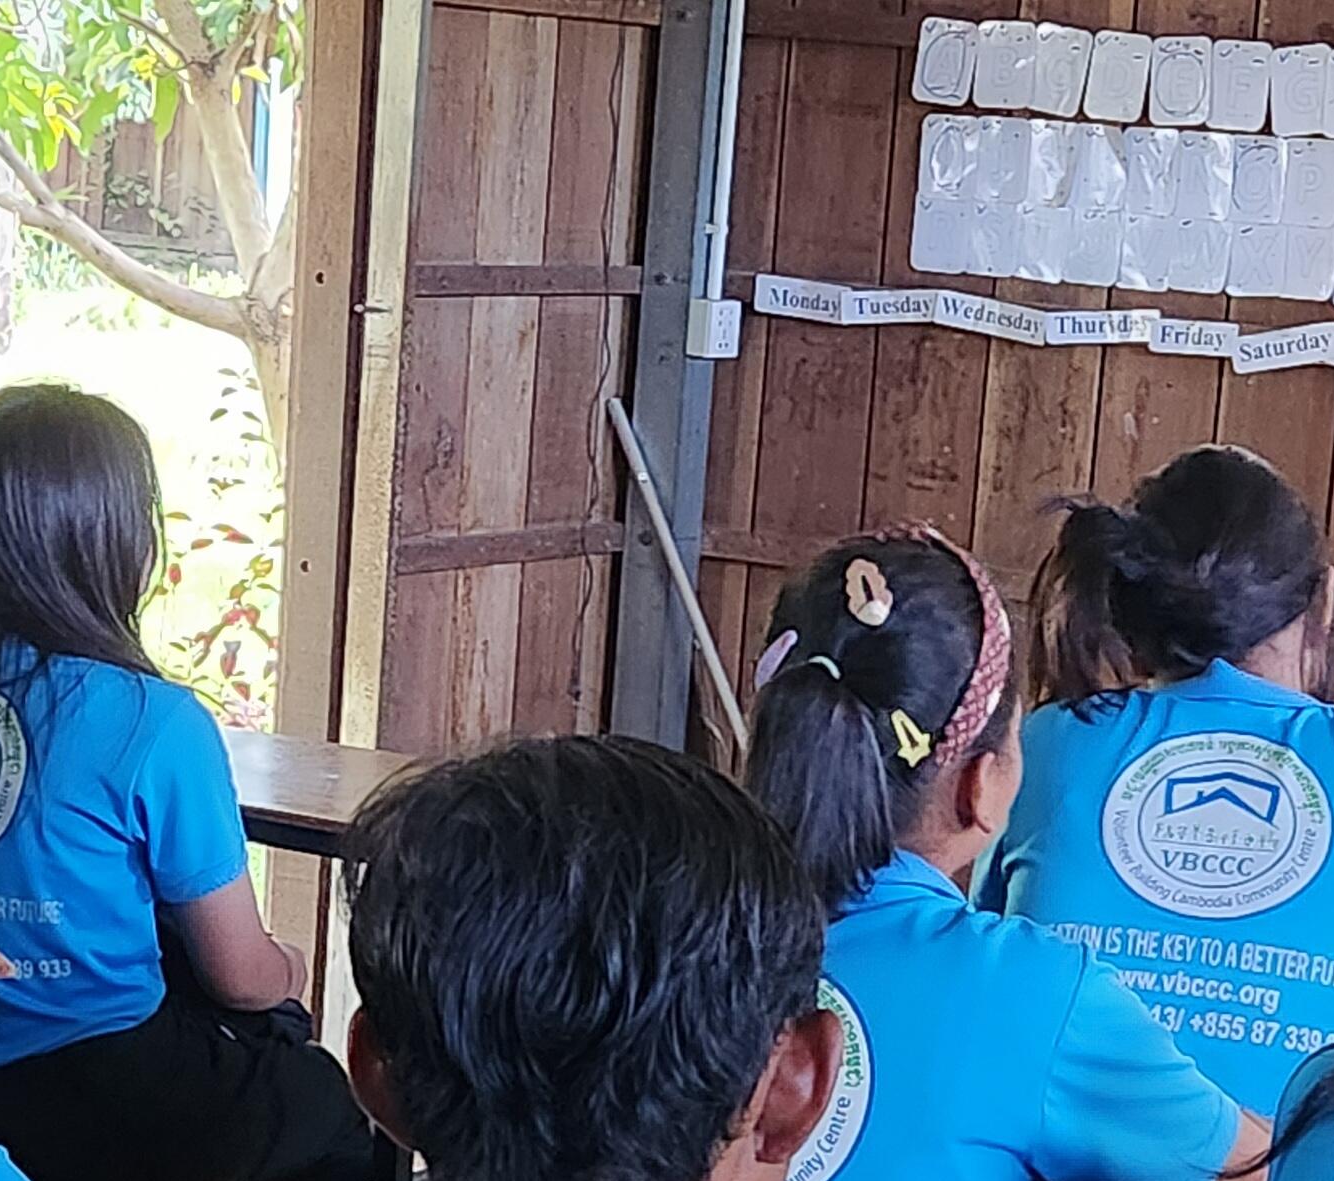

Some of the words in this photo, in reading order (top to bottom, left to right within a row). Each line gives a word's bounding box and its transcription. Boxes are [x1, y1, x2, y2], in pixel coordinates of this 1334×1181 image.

[769, 288, 840, 318] Monday
[853, 296, 933, 318] Tuesday
[942, 296, 1044, 338] Wednesday
[1160, 324, 1228, 352] Friday
[1239, 329, 1333, 363] Saturday
[1162, 848, 1256, 878] VBCCC
[38, 959, 71, 979] 933
[1105, 926, 1122, 954] IS
[1126, 928, 1161, 959] THE
[1162, 933, 1197, 962] KEY
[1200, 937, 1223, 967] TO
[1224, 941, 1238, 967] A
[1240, 942, 1310, 982] BETTER
[1116, 970, 1281, 1015] ww.vbccc.org
[1189, 1010, 1245, 1041] +855
[1250, 1018, 1281, 1047] 87
[1283, 1024, 1322, 1054] 339
[816, 1095, 852, 1158] Centre
